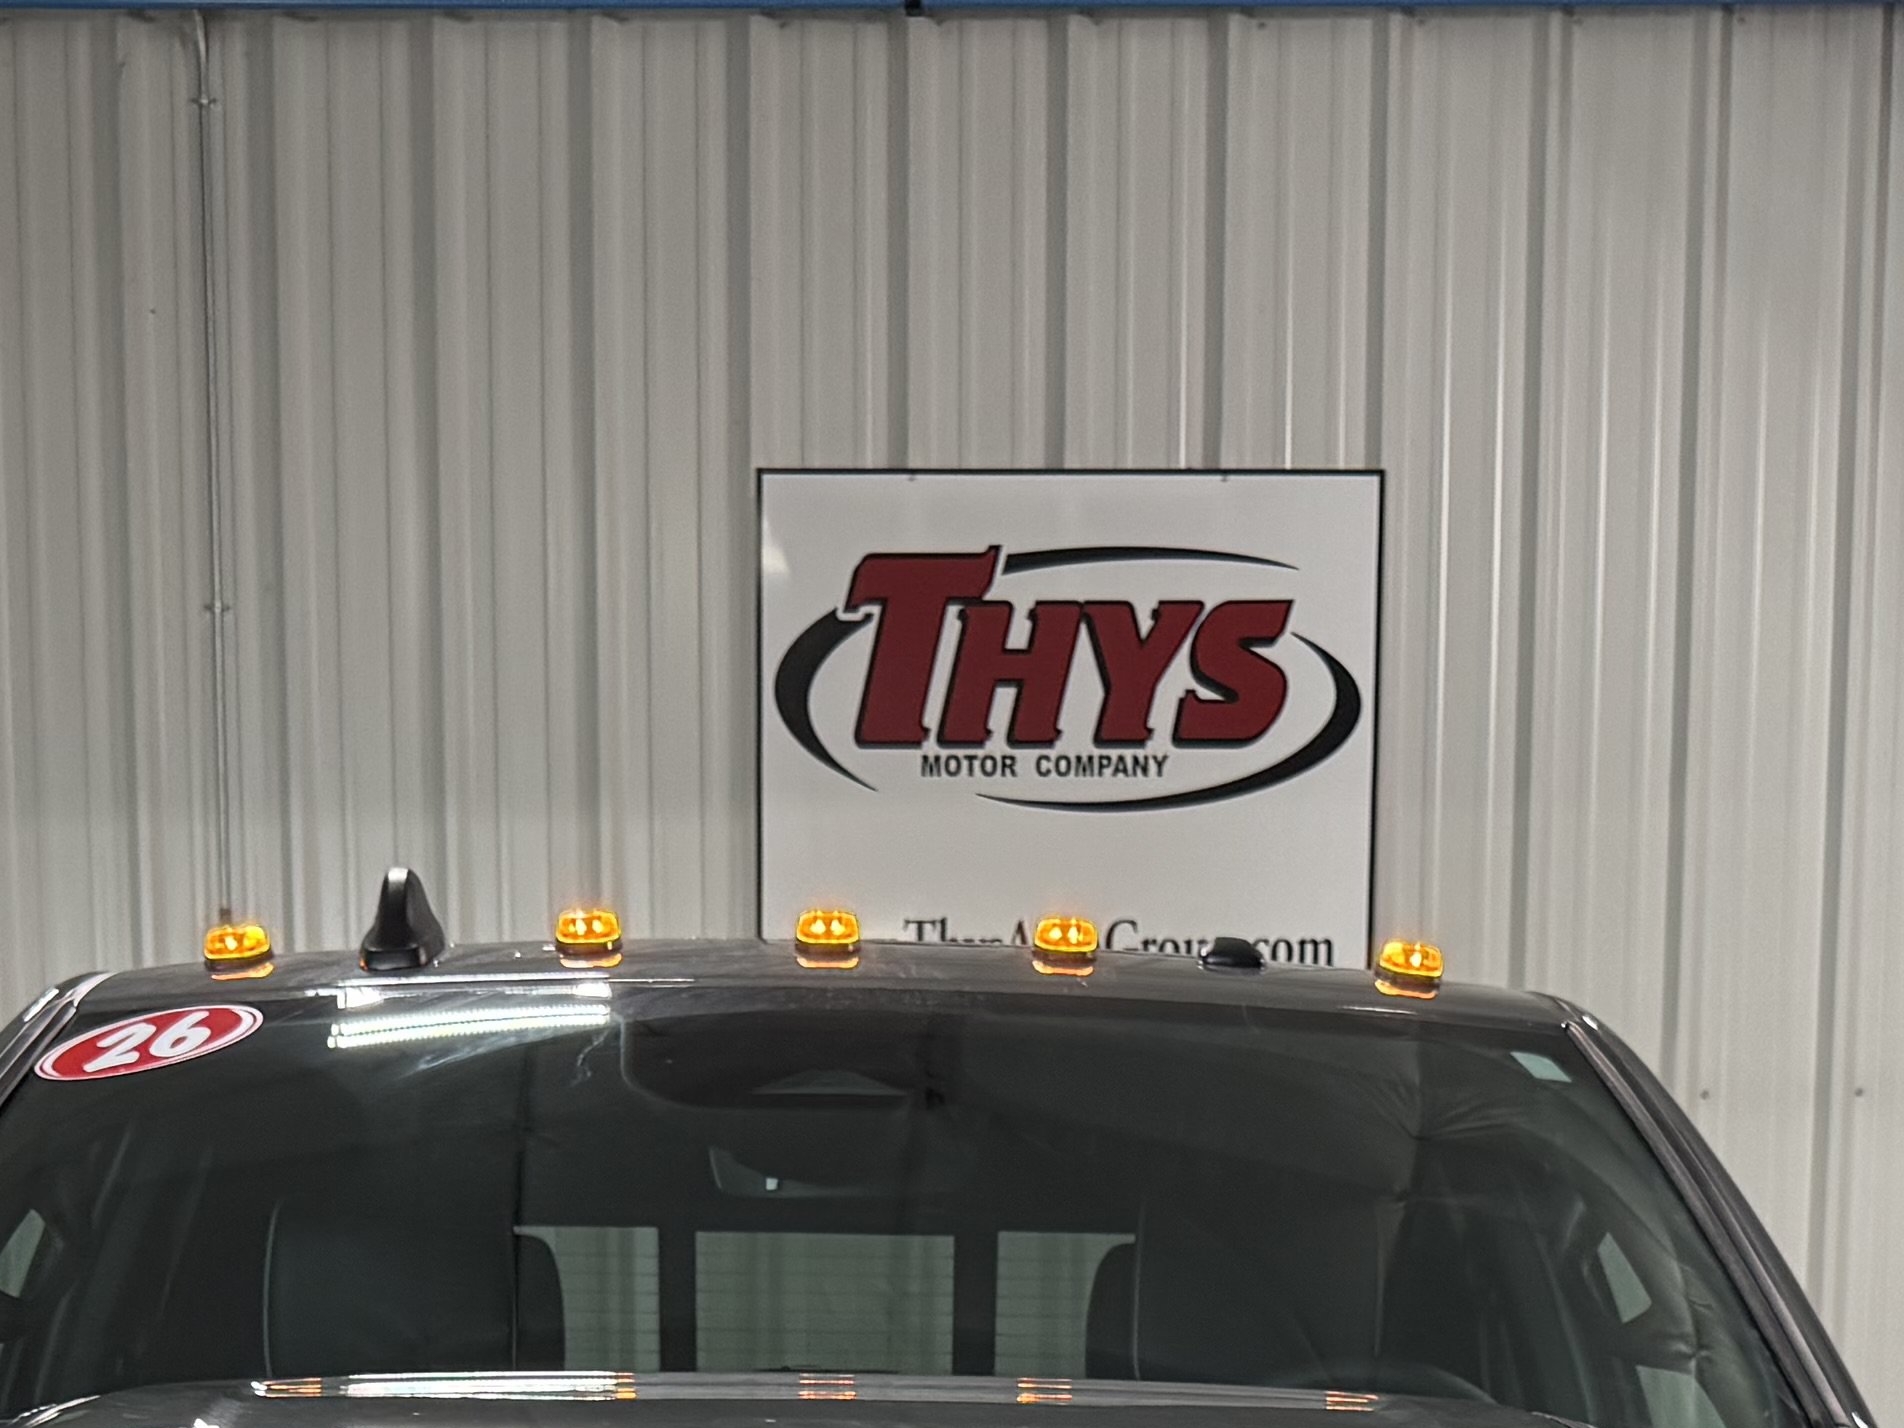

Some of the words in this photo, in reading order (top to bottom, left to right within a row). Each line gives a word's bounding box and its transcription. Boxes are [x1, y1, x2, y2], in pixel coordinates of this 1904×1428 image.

[841, 545, 1295, 749] THYS
[920, 755, 1018, 778] MOTOR
[1035, 755, 1169, 778] COMPANY
[83, 1010, 211, 1073] 26
